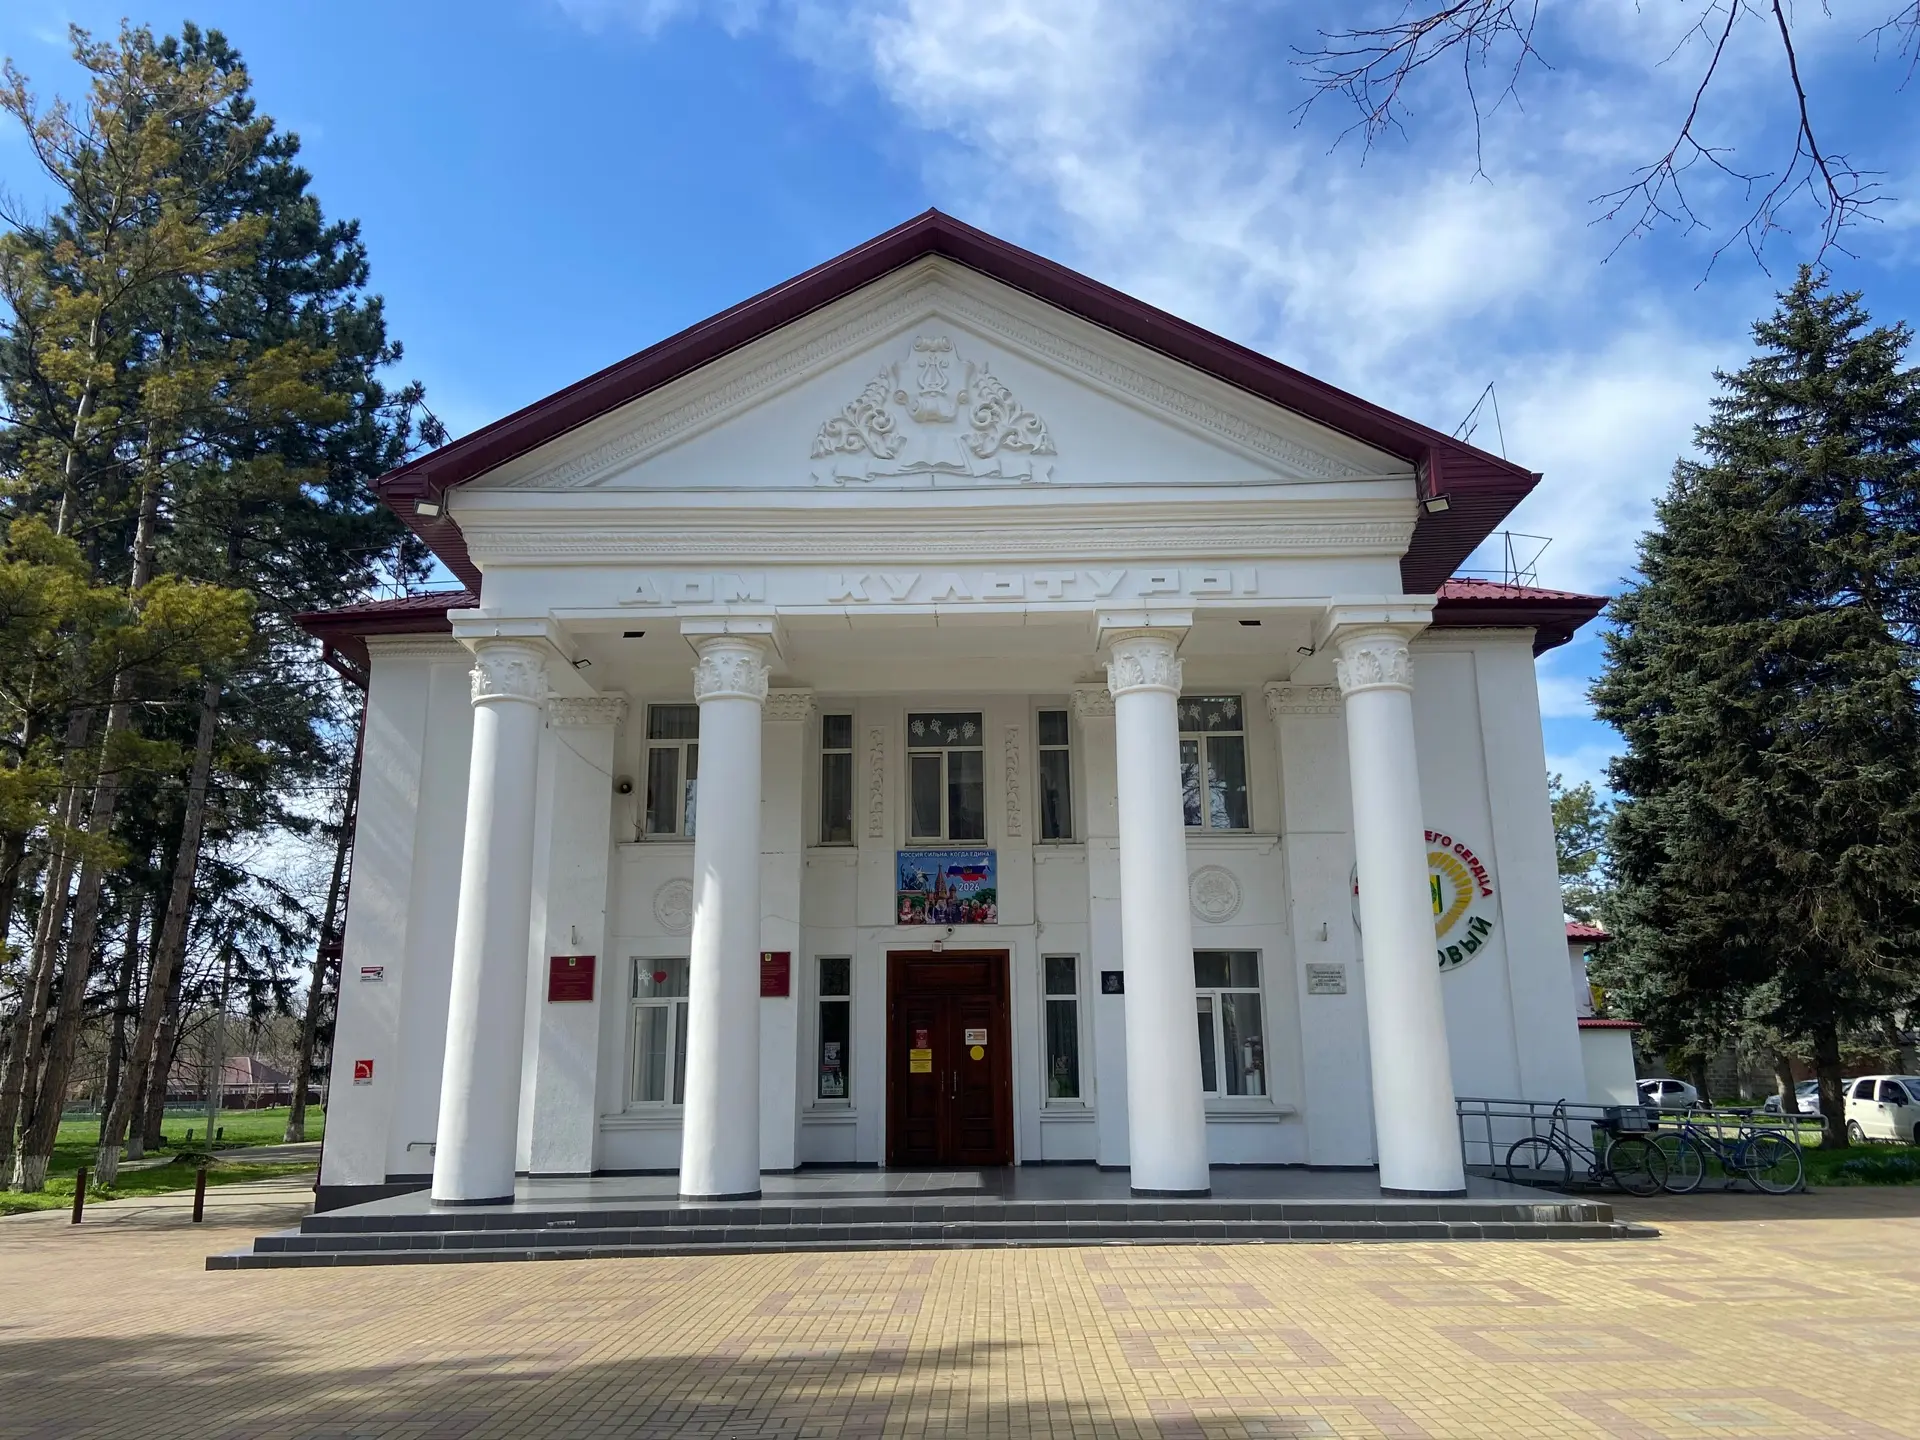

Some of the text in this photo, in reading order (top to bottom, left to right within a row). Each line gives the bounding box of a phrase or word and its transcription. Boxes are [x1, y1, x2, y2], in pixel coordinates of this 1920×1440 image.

[616, 567, 1259, 605] ДОМ КУЛЬТУРЫ
[1424, 830, 1493, 897] ЕГО СЕРДЦА
[958, 883, 980, 892] 2026
